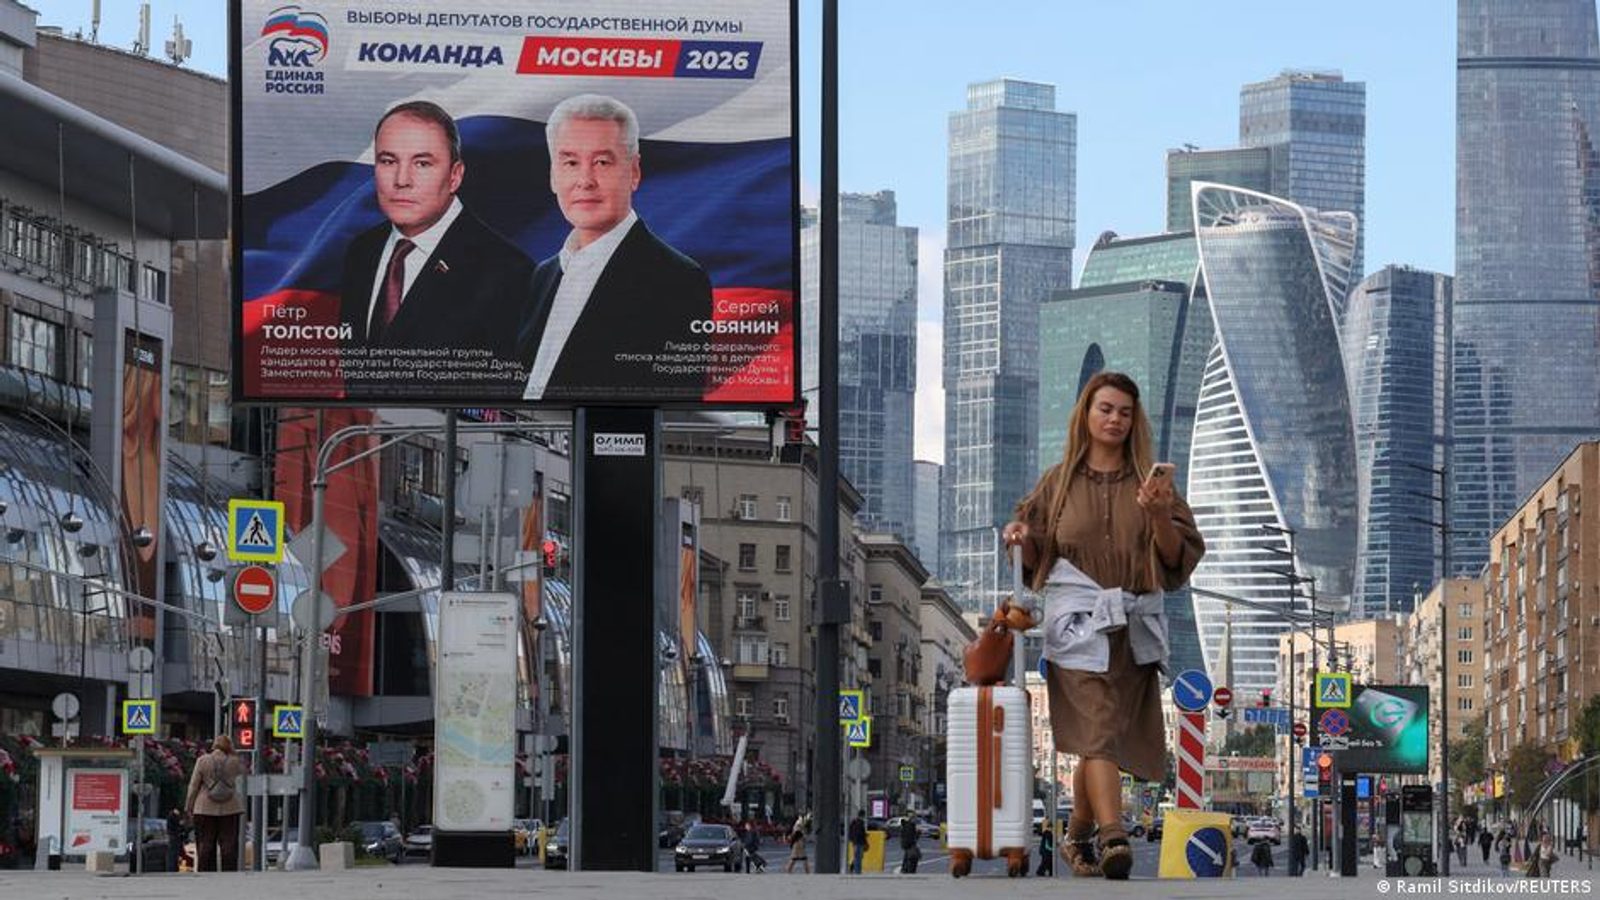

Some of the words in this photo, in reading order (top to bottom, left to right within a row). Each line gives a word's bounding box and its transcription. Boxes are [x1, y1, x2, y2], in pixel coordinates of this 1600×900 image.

[347, 10, 422, 26] ВЫБОРЫ
[426, 12, 523, 28] ДЕПУТАТОВ
[527, 15, 689, 32] ГОСУДАРСТВЕННОЙ
[692, 19, 743, 34] ДУМЫ
[358, 43, 504, 68] КОМАНДА
[535, 47, 664, 69] МОСКВЫ
[685, 50, 751, 71] 2026
[265, 70, 324, 82] ЕДИНАЯ
[265, 82, 324, 94] РОССИЯ
[263, 303, 308, 320] Пётр
[716, 299, 779, 316] Сергей
[262, 322, 352, 340] ТОЛСТОЙ
[690, 319, 779, 335] СОБЯНИН
[260, 345, 298, 356] Лидер
[300, 346, 368, 356] московской
[369, 347, 450, 358] региональной
[452, 348, 493, 359] группы
[665, 341, 700, 352] Лидер
[260, 357, 327, 367] кандидатов
[329, 359, 337, 367] в
[338, 358, 390, 369] депутаты
[393, 358, 488, 370] Государственной
[614, 353, 653, 363] списка
[655, 353, 719, 363] кандидатов
[721, 354, 728, 362] в
[260, 368, 332, 379] Заместитель
[335, 368, 414, 380] Председателя
